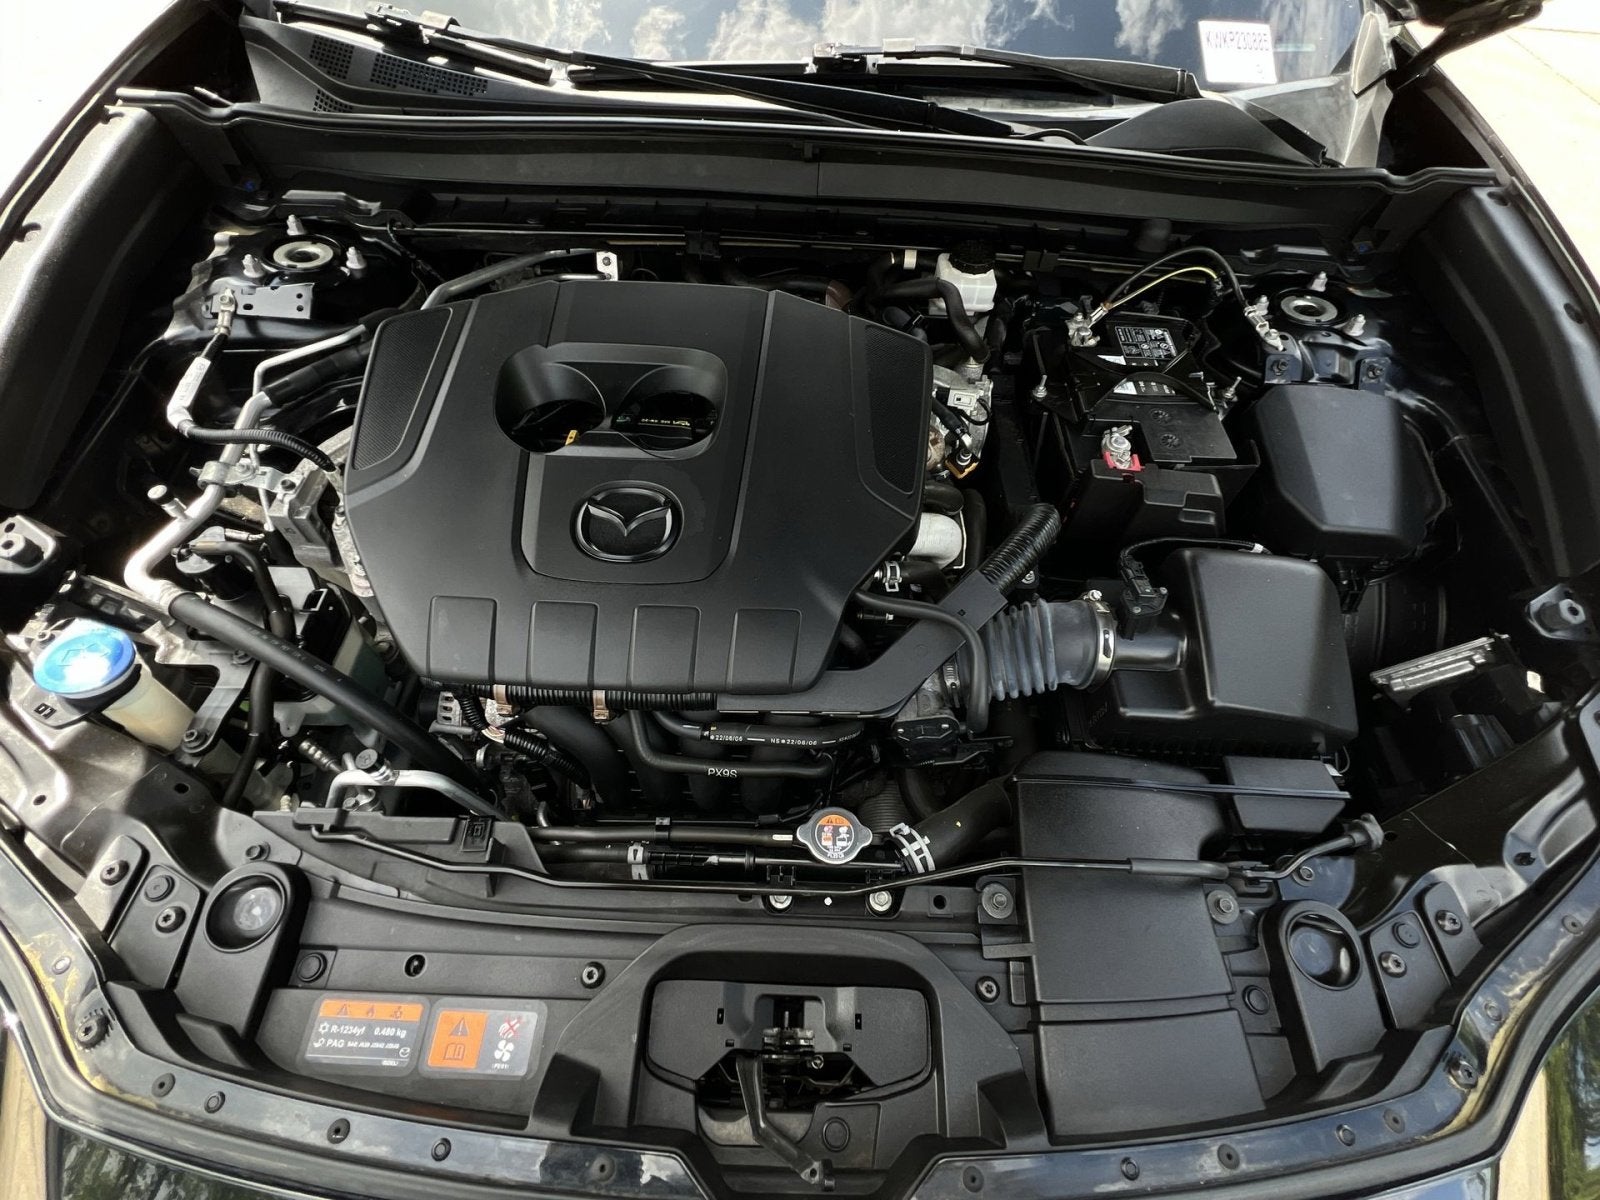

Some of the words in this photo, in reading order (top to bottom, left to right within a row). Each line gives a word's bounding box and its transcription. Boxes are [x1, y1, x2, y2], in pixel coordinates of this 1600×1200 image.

[330, 1024, 366, 1037] R-1234yf
[396, 1029, 407, 1039] kg
[326, 1039, 345, 1049] PAG
